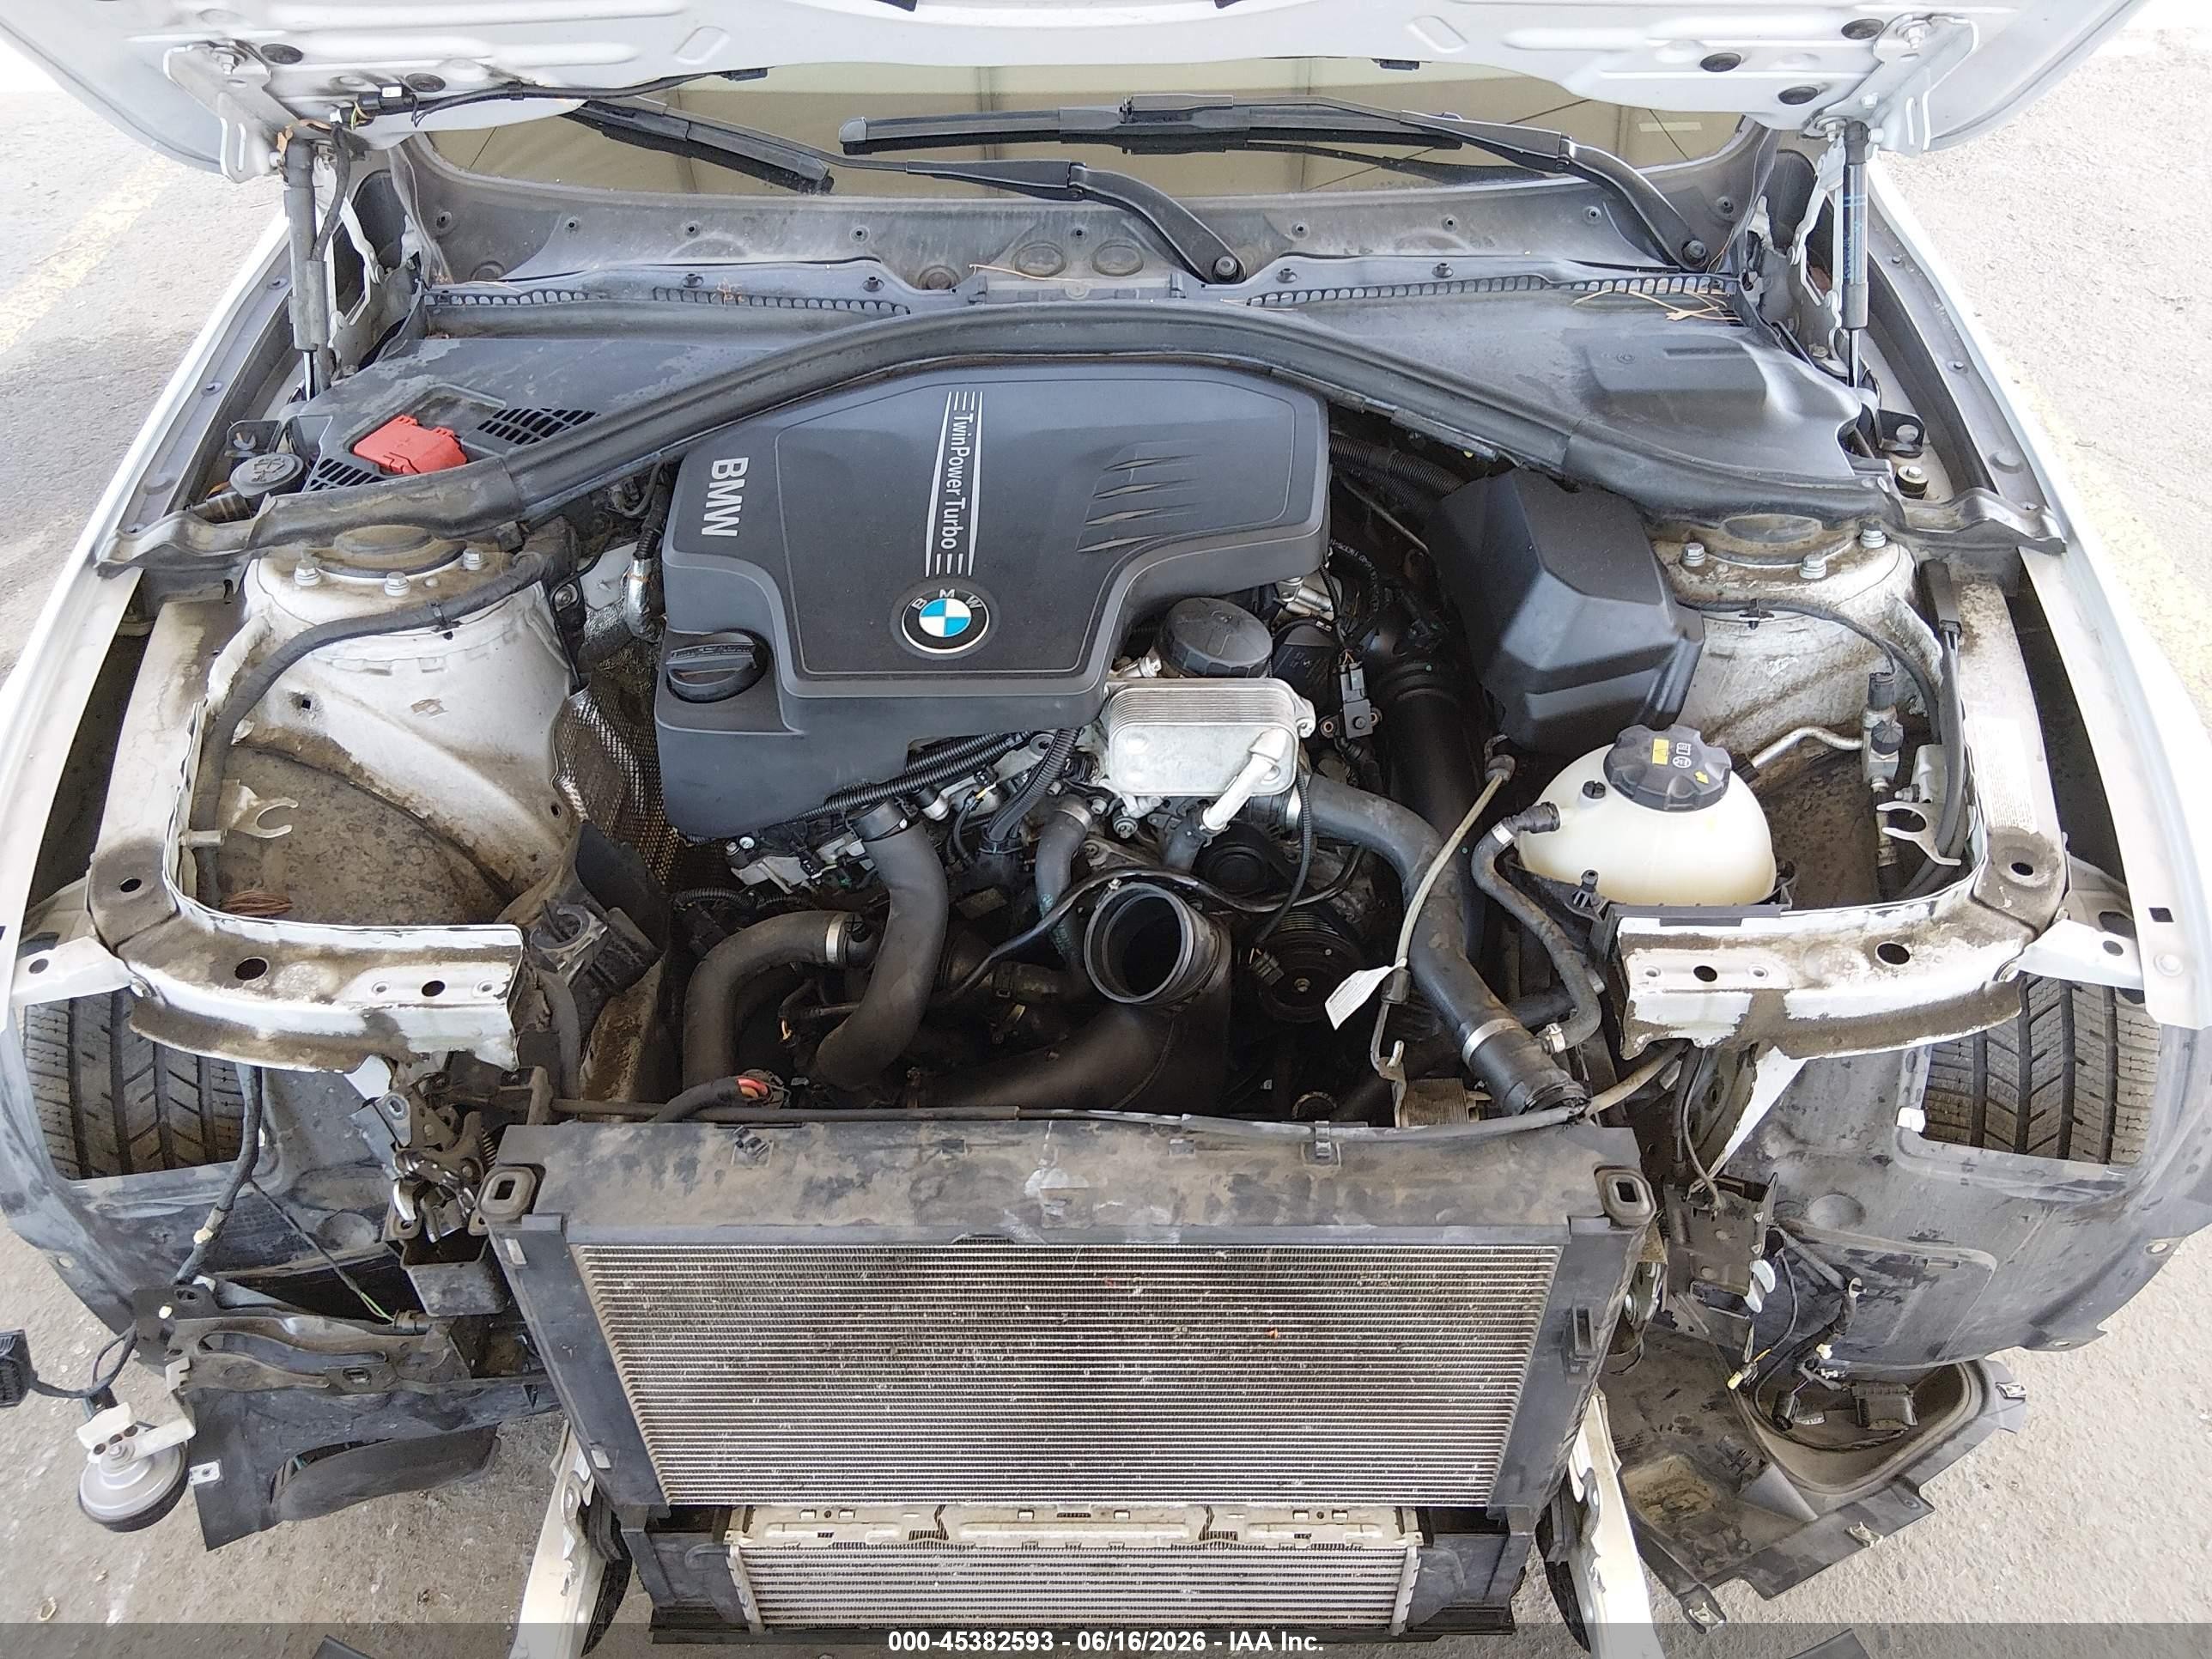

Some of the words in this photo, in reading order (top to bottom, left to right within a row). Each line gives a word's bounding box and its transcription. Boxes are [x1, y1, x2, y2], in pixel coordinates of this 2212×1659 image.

[945, 413, 973, 495] TwinPower
[702, 457, 749, 537] BMW
[941, 497, 967, 550] Turbo
[911, 588, 982, 611] BMW
